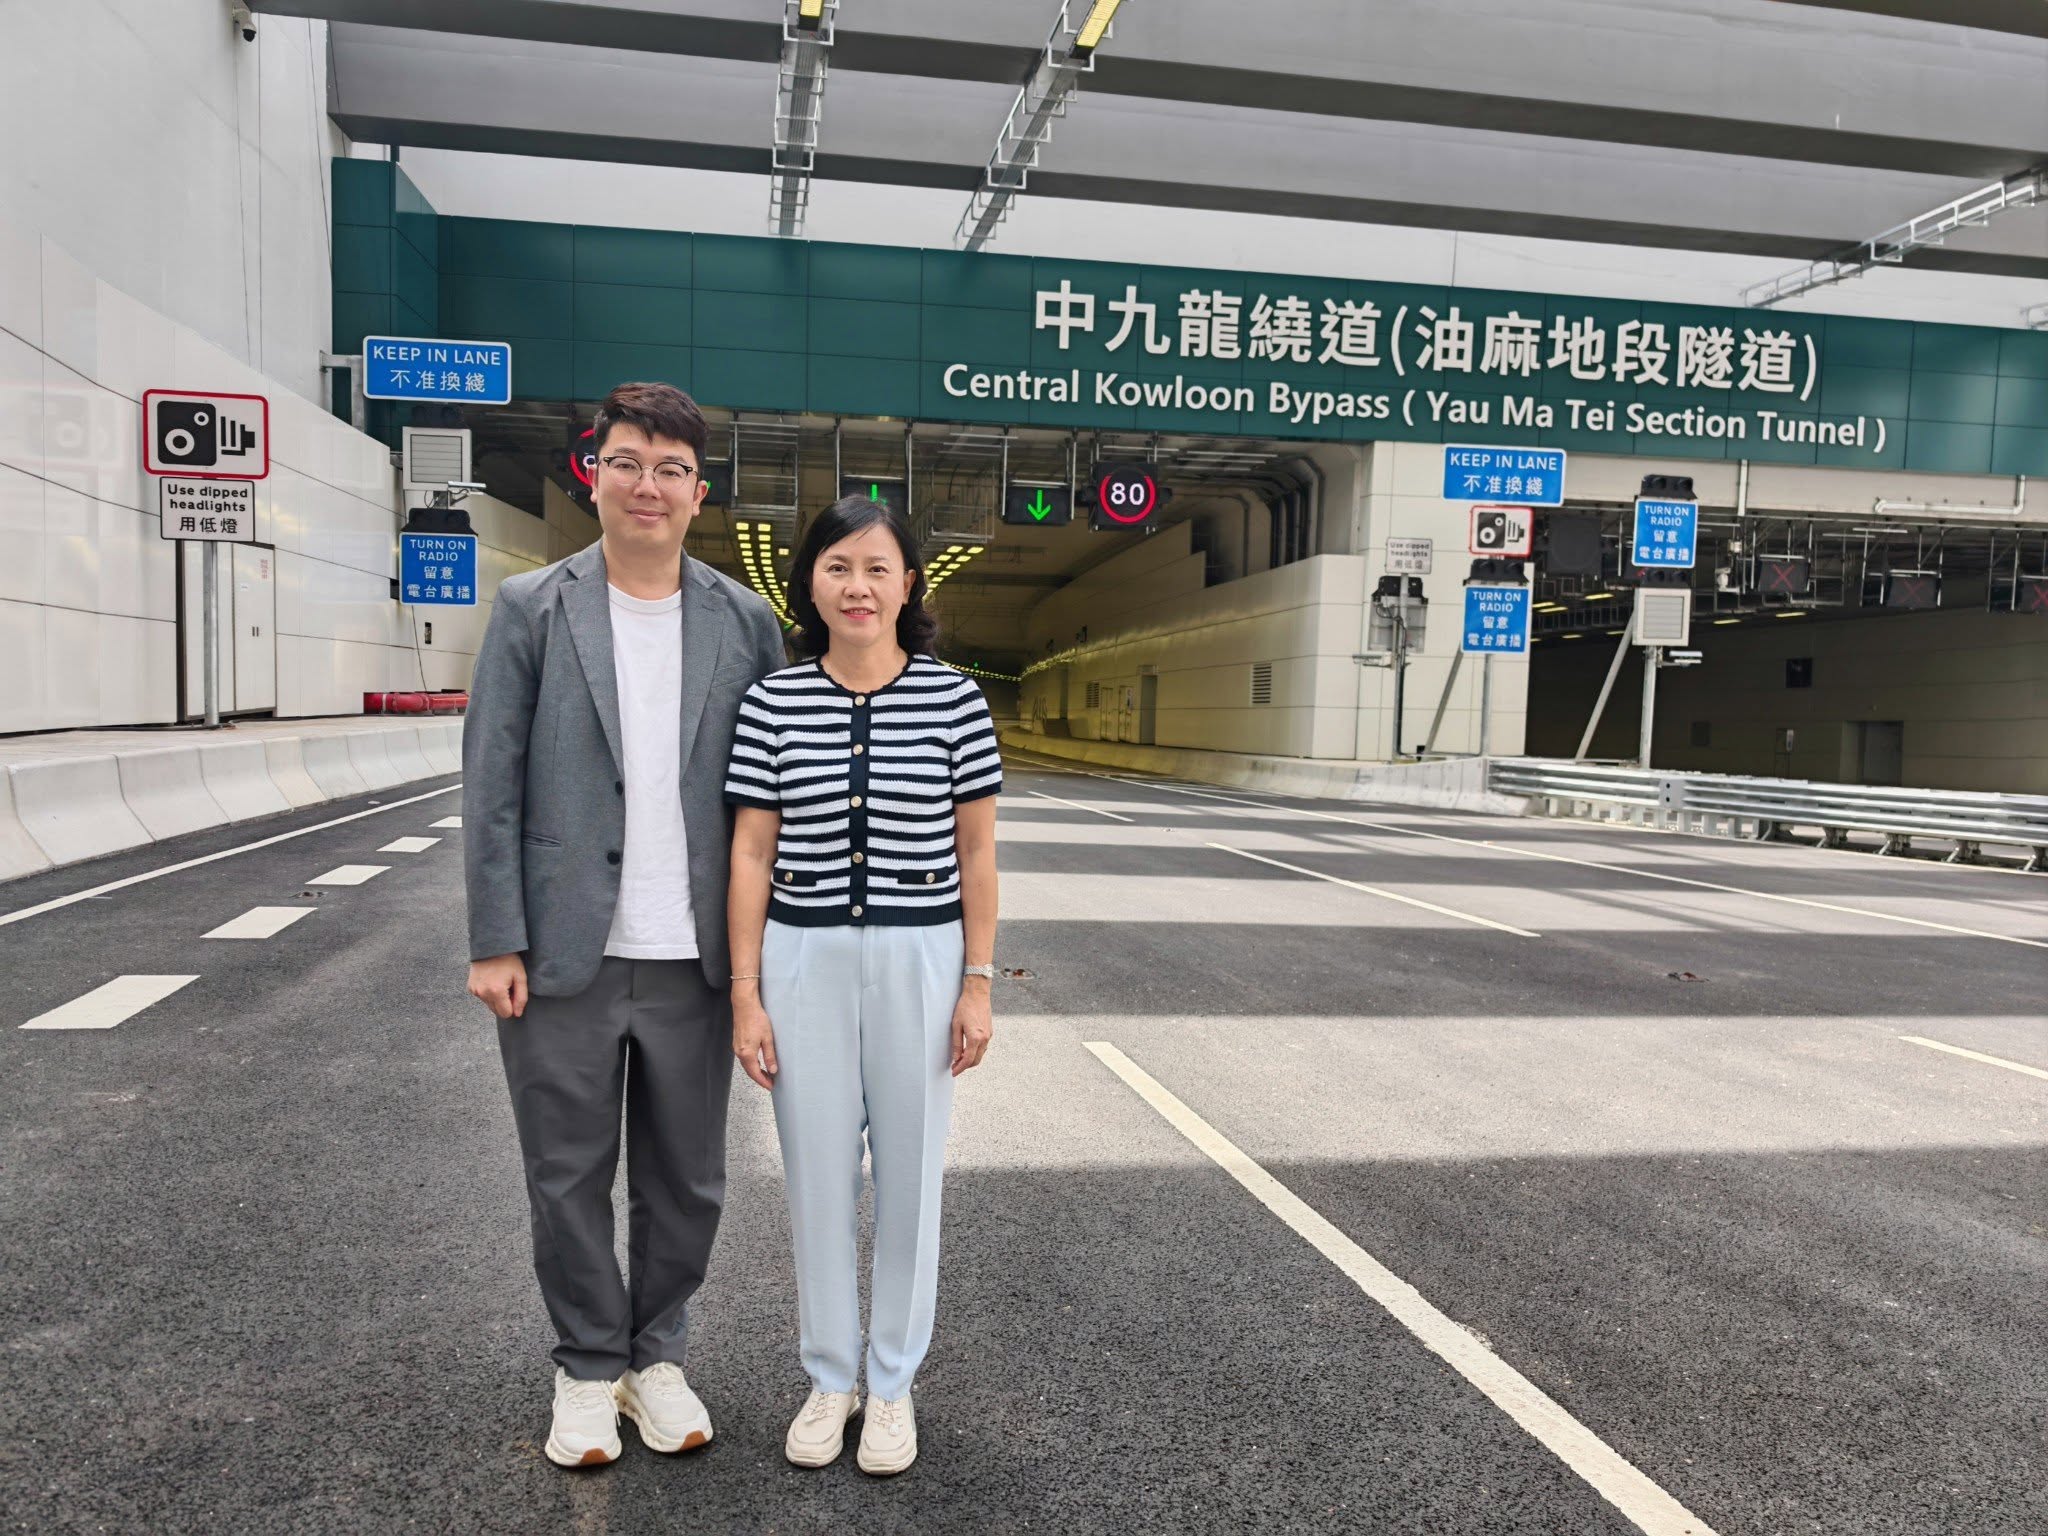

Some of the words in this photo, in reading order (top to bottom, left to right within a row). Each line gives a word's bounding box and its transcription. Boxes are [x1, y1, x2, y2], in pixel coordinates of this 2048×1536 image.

[373, 345, 421, 361] KEEP
[428, 348, 447, 363] IN
[454, 350, 501, 366] LANE
[943, 363, 1079, 403] Central
[1095, 373, 1254, 412] Kowloon
[1269, 382, 1390, 424] Bypass
[1427, 391, 1489, 424] Yau
[1502, 395, 1553, 428] Ma
[1566, 399, 1615, 431] Tei
[1625, 403, 1746, 439] Section
[1756, 411, 1865, 447] Tunnel
[1450, 453, 1491, 467] KEEP
[1496, 455, 1513, 468] IN
[1518, 456, 1557, 471] LANE
[167, 484, 195, 496] Use
[199, 486, 248, 499] dipped
[1110, 482, 1145, 506] 80
[169, 499, 246, 513] headlights
[1645, 505, 1672, 516] TURN
[1673, 506, 1689, 517] ON
[180, 516, 238, 534] 用低燈
[1650, 516, 1682, 526] RADIO
[410, 539, 444, 549] TURN
[448, 540, 466, 550] ON
[419, 551, 459, 561] RADIO
[424, 566, 454, 580] 留意
[407, 584, 470, 599] 電台廣播
[1473, 591, 1502, 601] TURN
[1505, 592, 1521, 602] ON
[1479, 602, 1513, 612] RADIO
